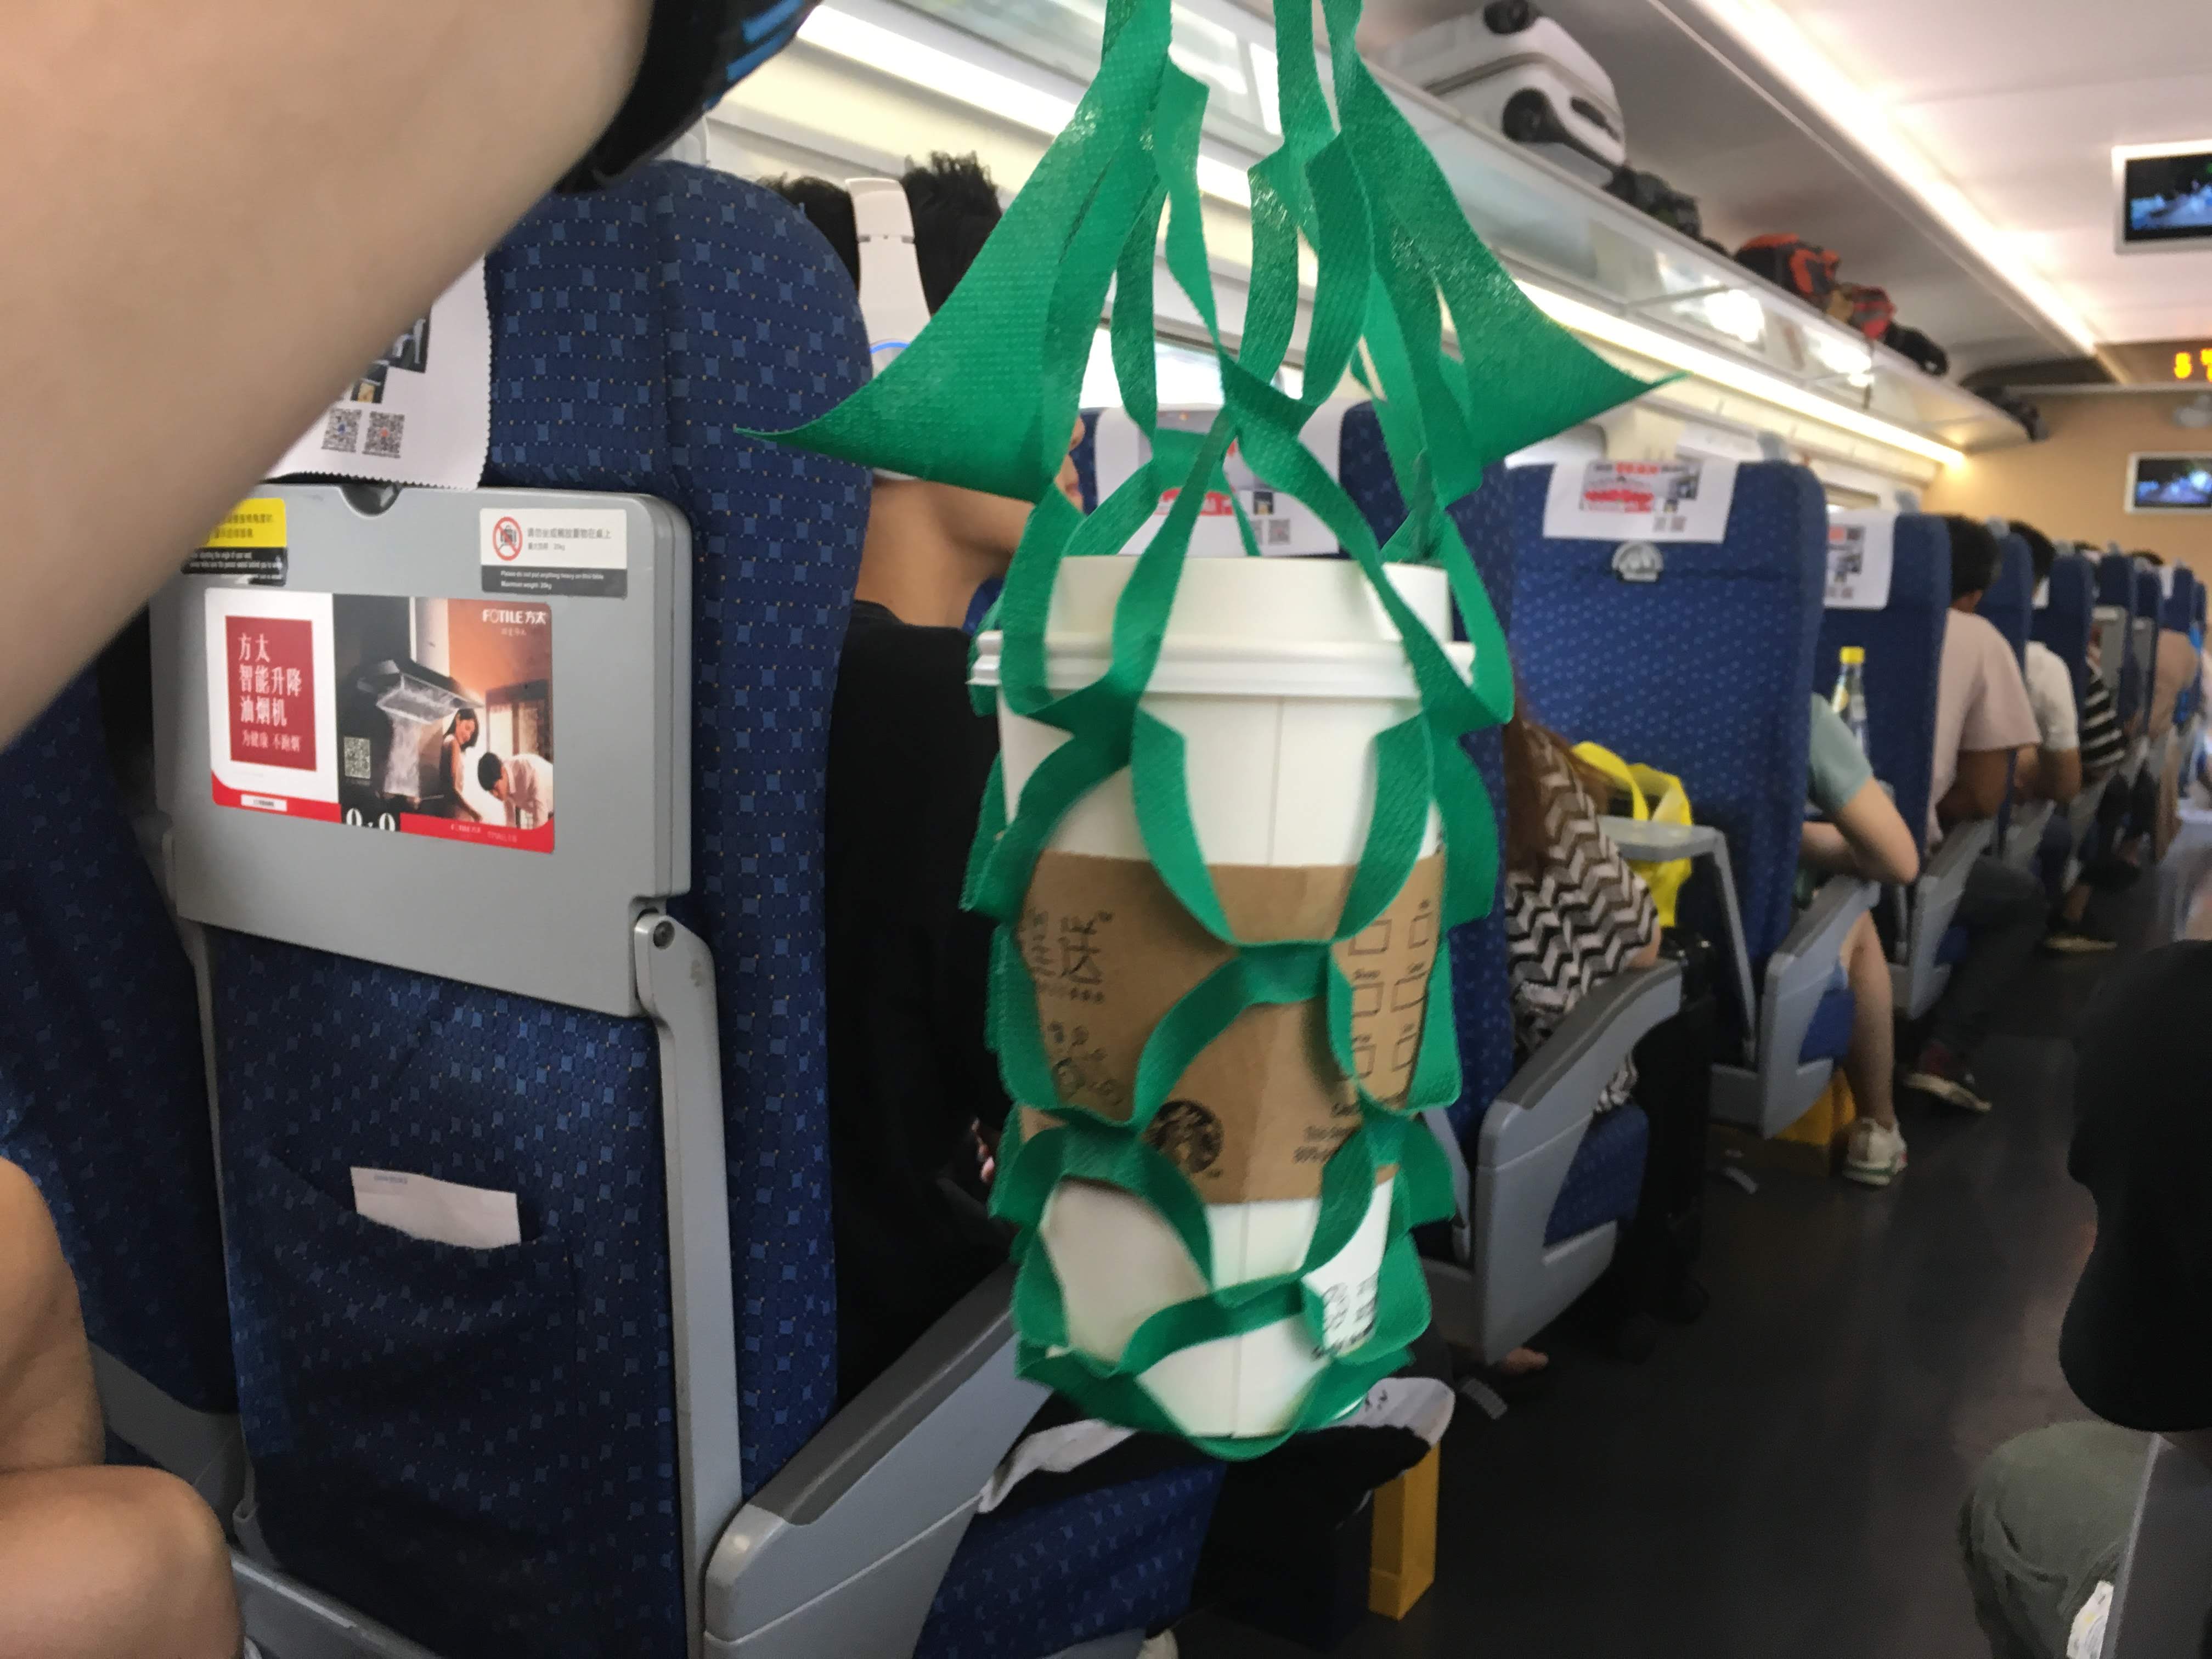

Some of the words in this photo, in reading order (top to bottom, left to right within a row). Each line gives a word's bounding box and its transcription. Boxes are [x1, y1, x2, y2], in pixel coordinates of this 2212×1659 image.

[482, 609, 523, 624] FOTILE
[525, 611, 547, 625] 方太
[238, 633, 270, 663] 方太
[239, 663, 302, 696] 智能升降
[240, 695, 287, 727] 油烟机
